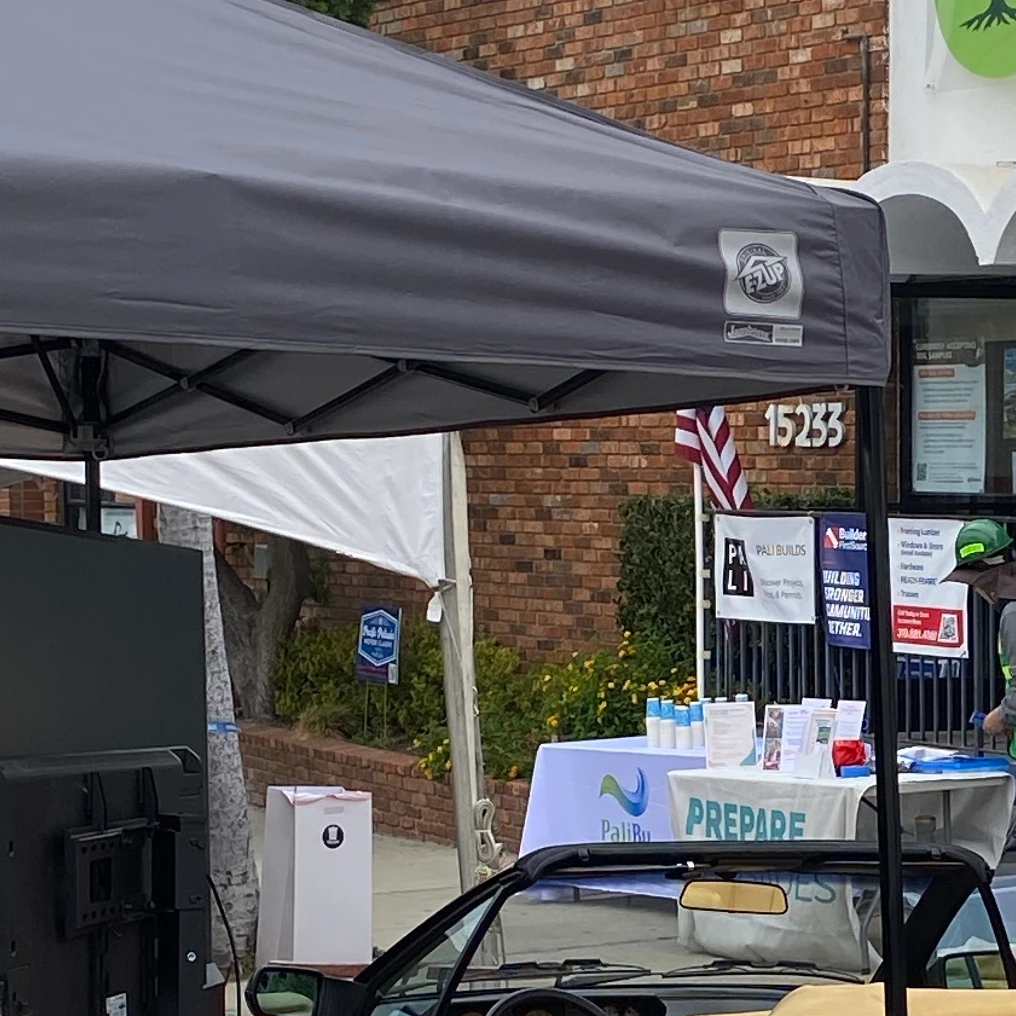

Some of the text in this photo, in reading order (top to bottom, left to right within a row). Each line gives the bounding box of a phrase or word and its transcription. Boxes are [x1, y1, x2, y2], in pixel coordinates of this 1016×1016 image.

[764, 402, 846, 448] 15233
[755, 544, 806, 556] PALI BUILDS
[685, 797, 806, 841] PREPARE
